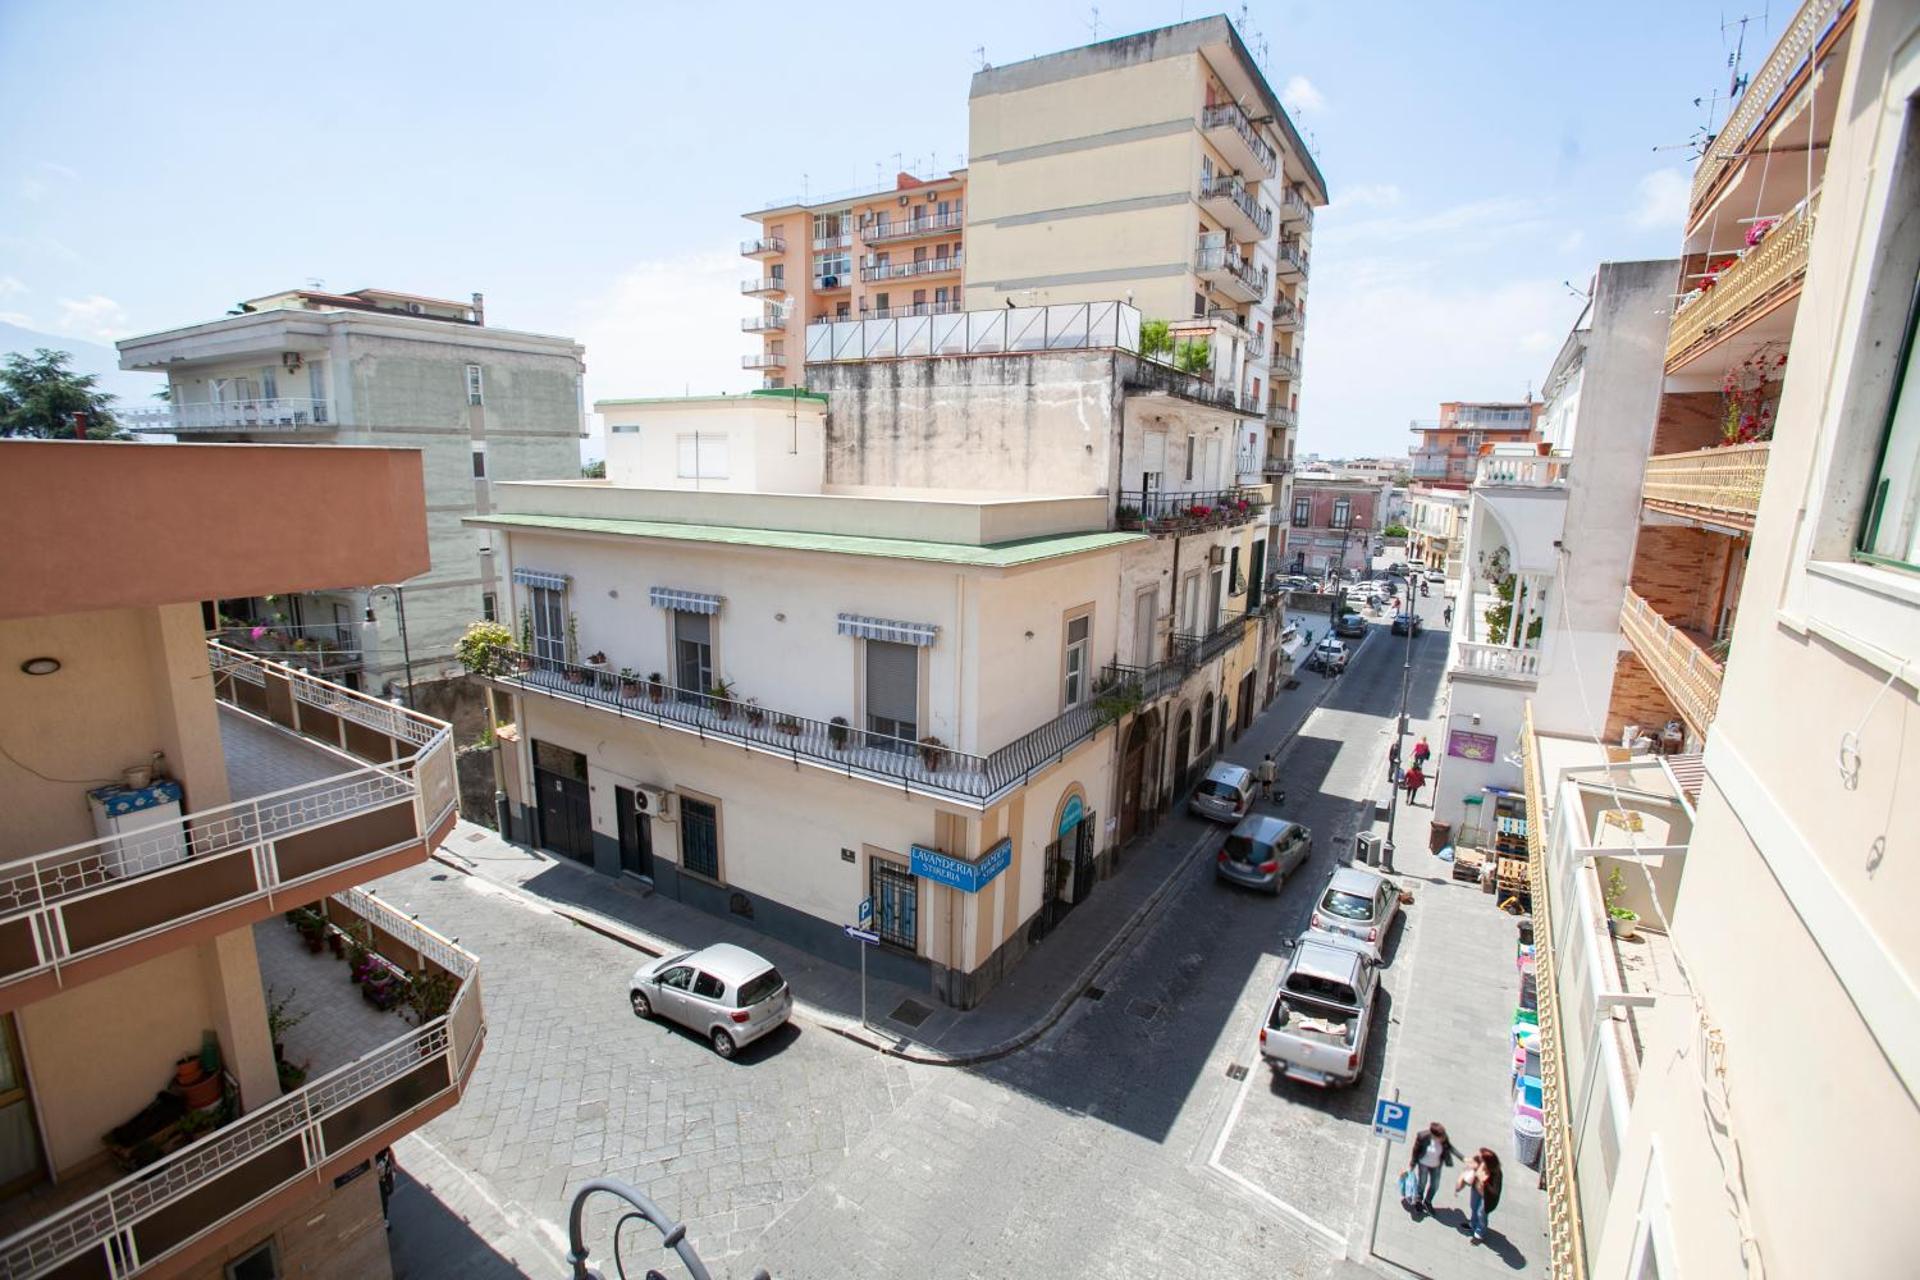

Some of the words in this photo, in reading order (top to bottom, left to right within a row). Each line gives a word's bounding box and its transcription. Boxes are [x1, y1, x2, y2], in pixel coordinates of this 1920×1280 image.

[912, 848, 973, 877] LAVANDERIA
[922, 863, 960, 881] STIRERIA
[861, 901, 870, 919] P
[1382, 1104, 1404, 1124] P
